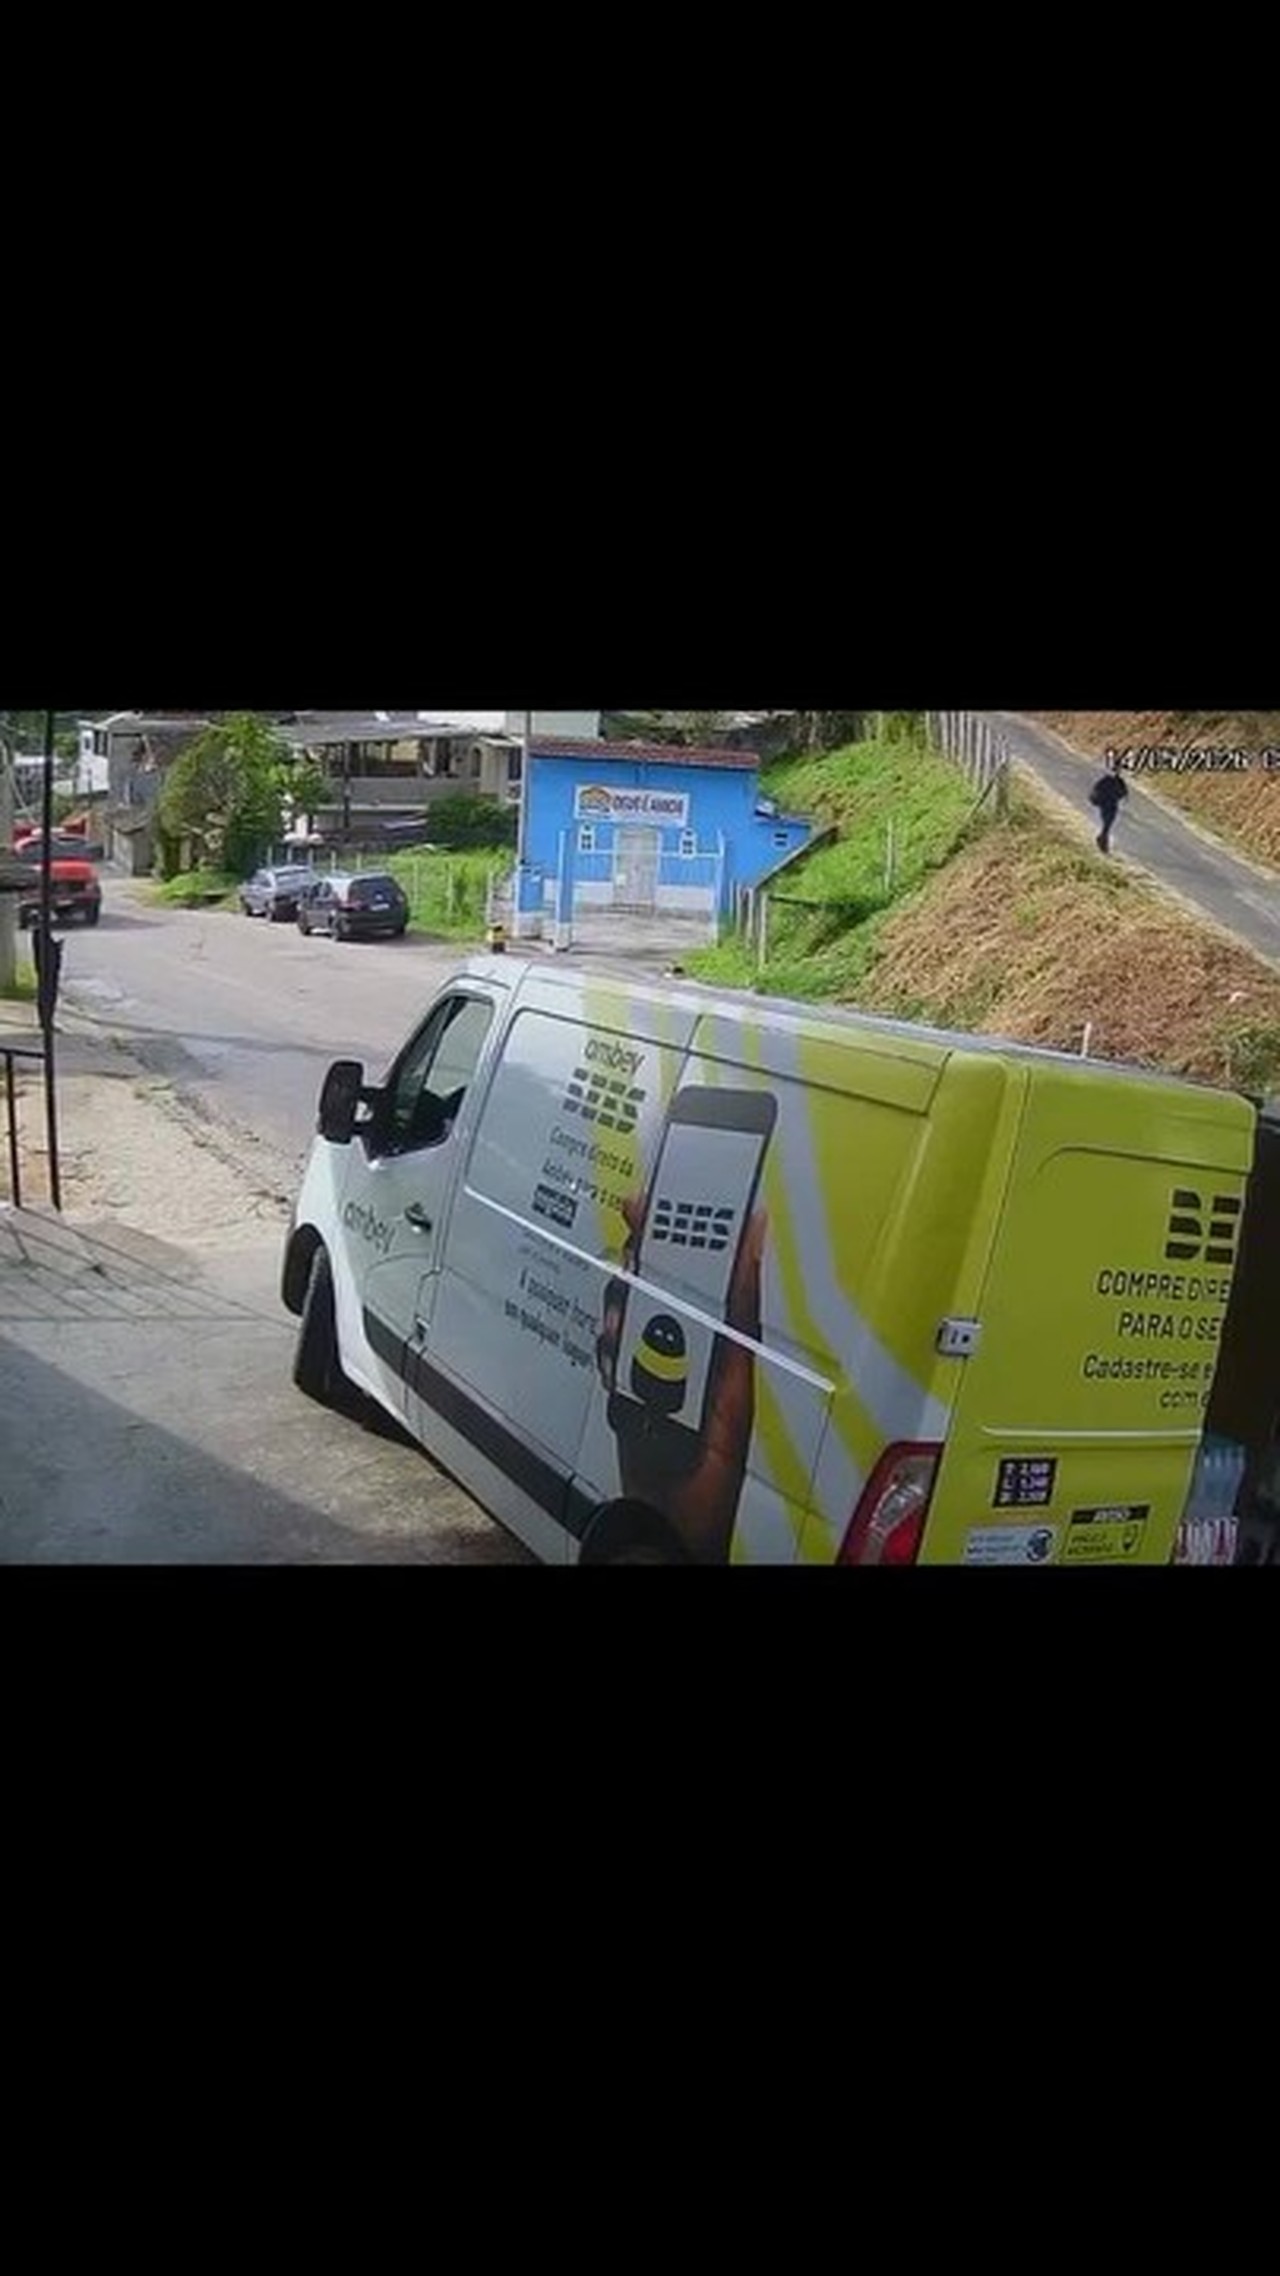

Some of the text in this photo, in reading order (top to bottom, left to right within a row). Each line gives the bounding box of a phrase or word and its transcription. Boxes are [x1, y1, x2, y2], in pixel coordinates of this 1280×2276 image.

[1097, 1269, 1185, 1301] COMPRE
[1117, 1310, 1174, 1339] PARA
[1178, 1315, 1194, 1340] O
[1083, 1354, 1200, 1380] Cadastre-se
